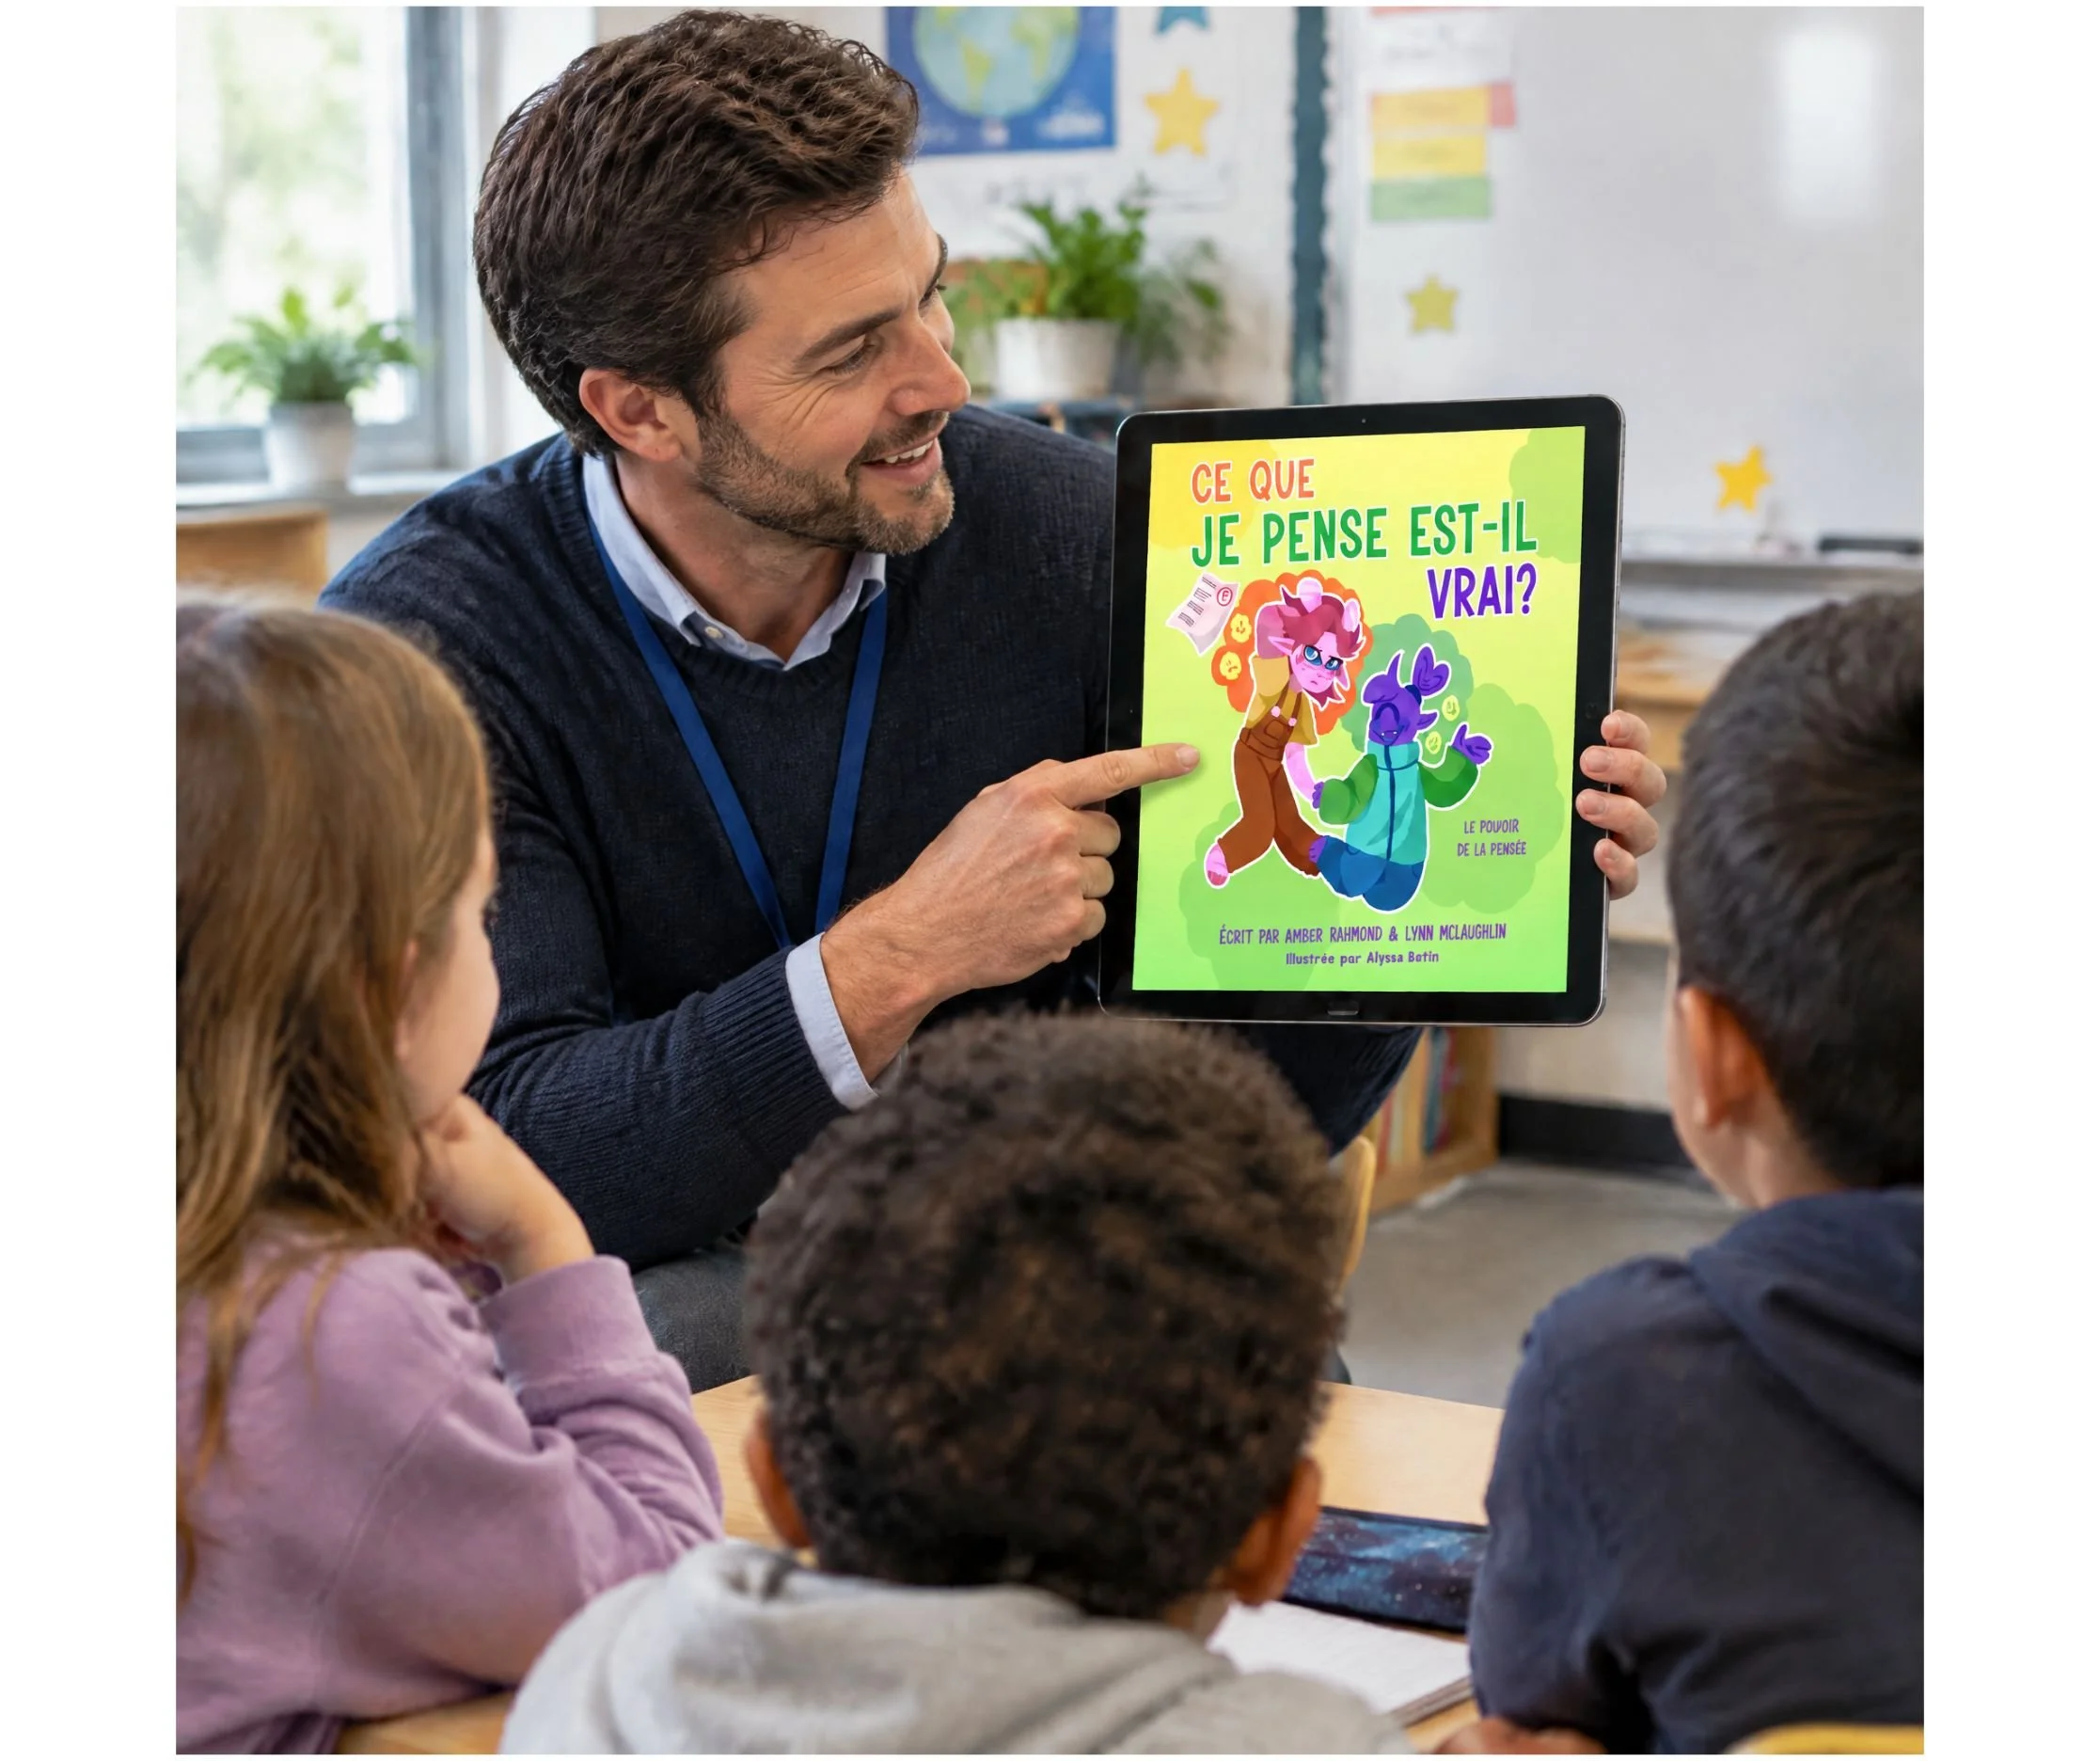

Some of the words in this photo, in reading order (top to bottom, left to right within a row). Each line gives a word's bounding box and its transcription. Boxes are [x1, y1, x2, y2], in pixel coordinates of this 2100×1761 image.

[1192, 464, 1231, 503] CE
[1250, 459, 1315, 501] QUE
[1192, 516, 1239, 567] JE
[1264, 509, 1386, 563] PENSE
[1411, 501, 1537, 556] EST-IL
[1428, 563, 1537, 619] VRAI?
[1463, 820, 1476, 834] LE
[1457, 842, 1470, 857] DE
[1474, 842, 1487, 857] LA
[1490, 838, 1527, 856] PENSÉE
[1219, 924, 1254, 945] ÉCRIT
[1258, 928, 1280, 944] PAR
[1285, 927, 1323, 944] AMBER
[1329, 925, 1383, 944] RAHMOND
[1388, 925, 1398, 942] &
[1405, 925, 1434, 942] LYNN
[1439, 922, 1507, 941] MCLAUGHLIN
[1286, 952, 1335, 965] Illustrée
[1339, 955, 1362, 967] par
[1366, 951, 1404, 967] Alyssa
